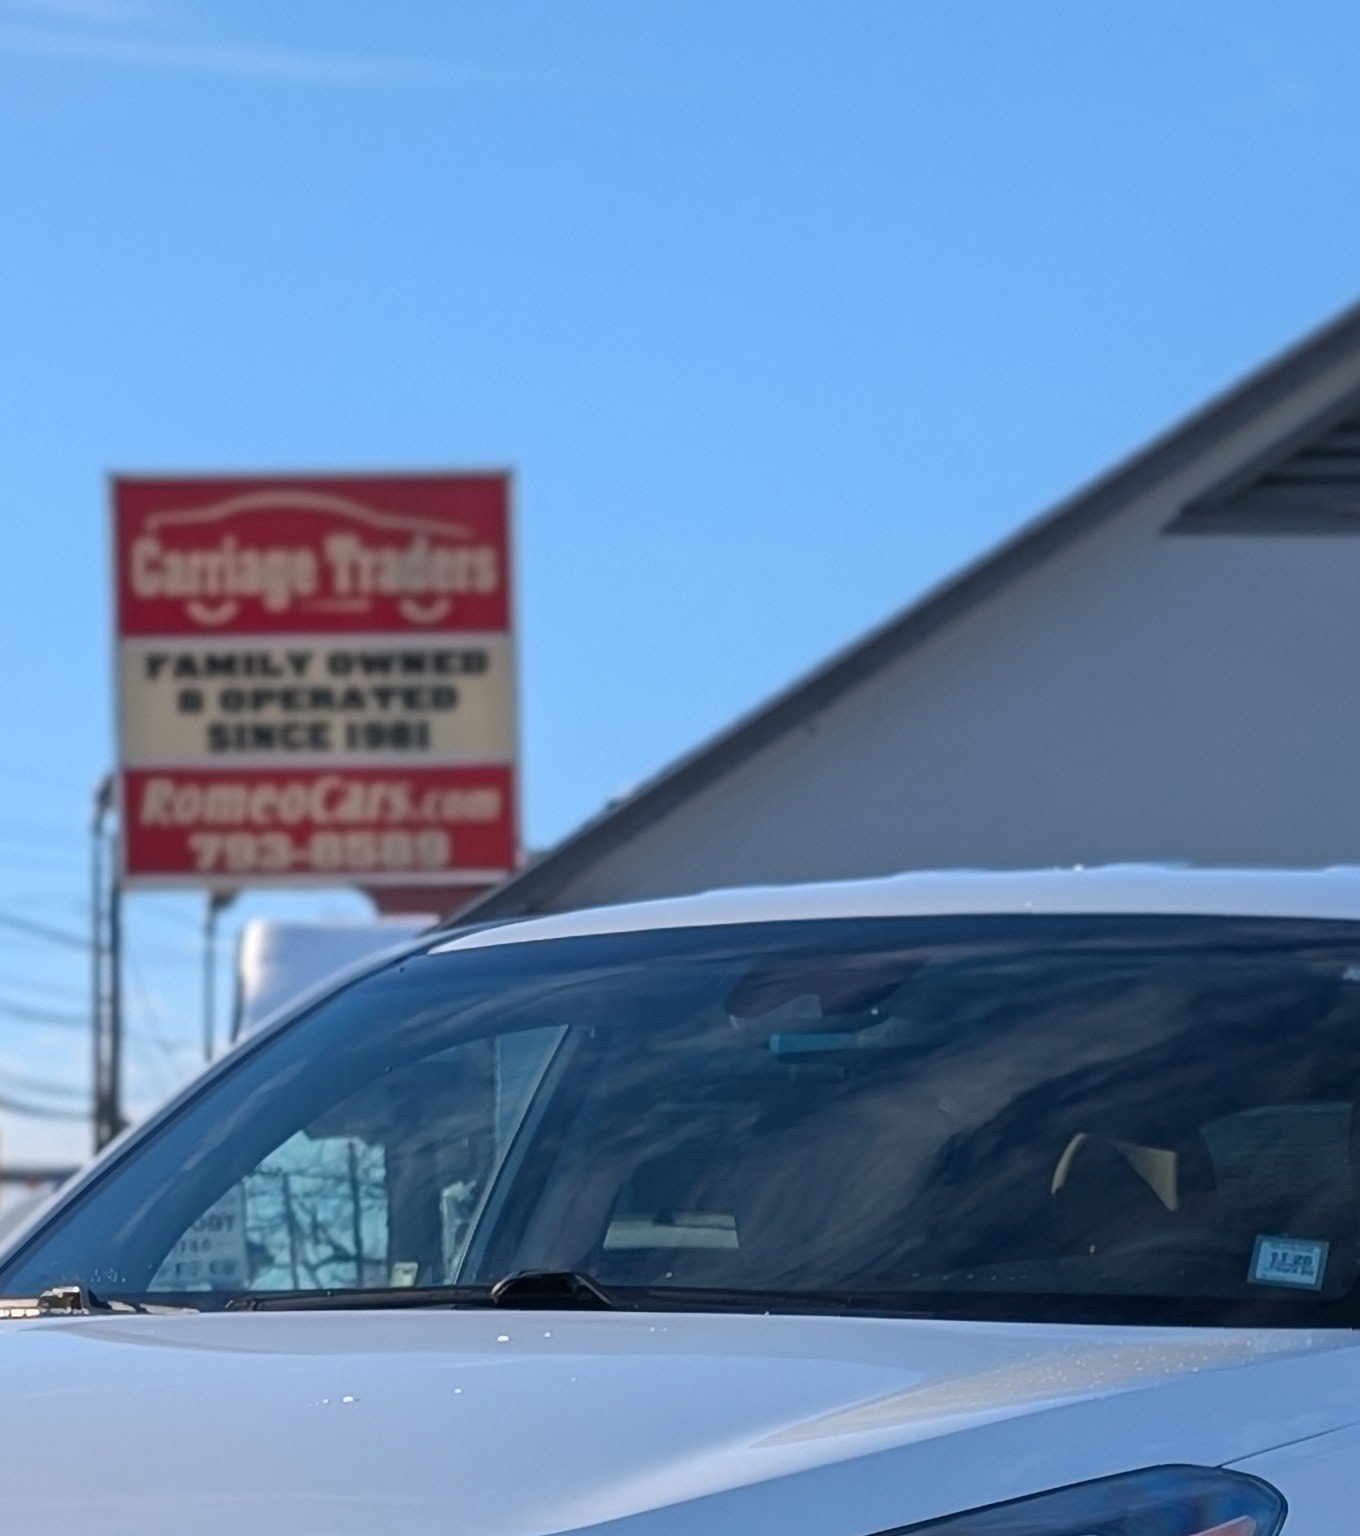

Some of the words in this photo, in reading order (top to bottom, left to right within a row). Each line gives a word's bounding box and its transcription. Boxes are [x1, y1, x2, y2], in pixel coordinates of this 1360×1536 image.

[132, 535, 316, 609] Carriage
[325, 533, 497, 594] Traders
[148, 653, 311, 678] FAMILY
[329, 651, 488, 676] OWNED
[220, 687, 457, 712] OPERATED
[210, 725, 330, 751] SINCE
[348, 723, 429, 750] 1981
[144, 778, 500, 824] RomeoCars.com
